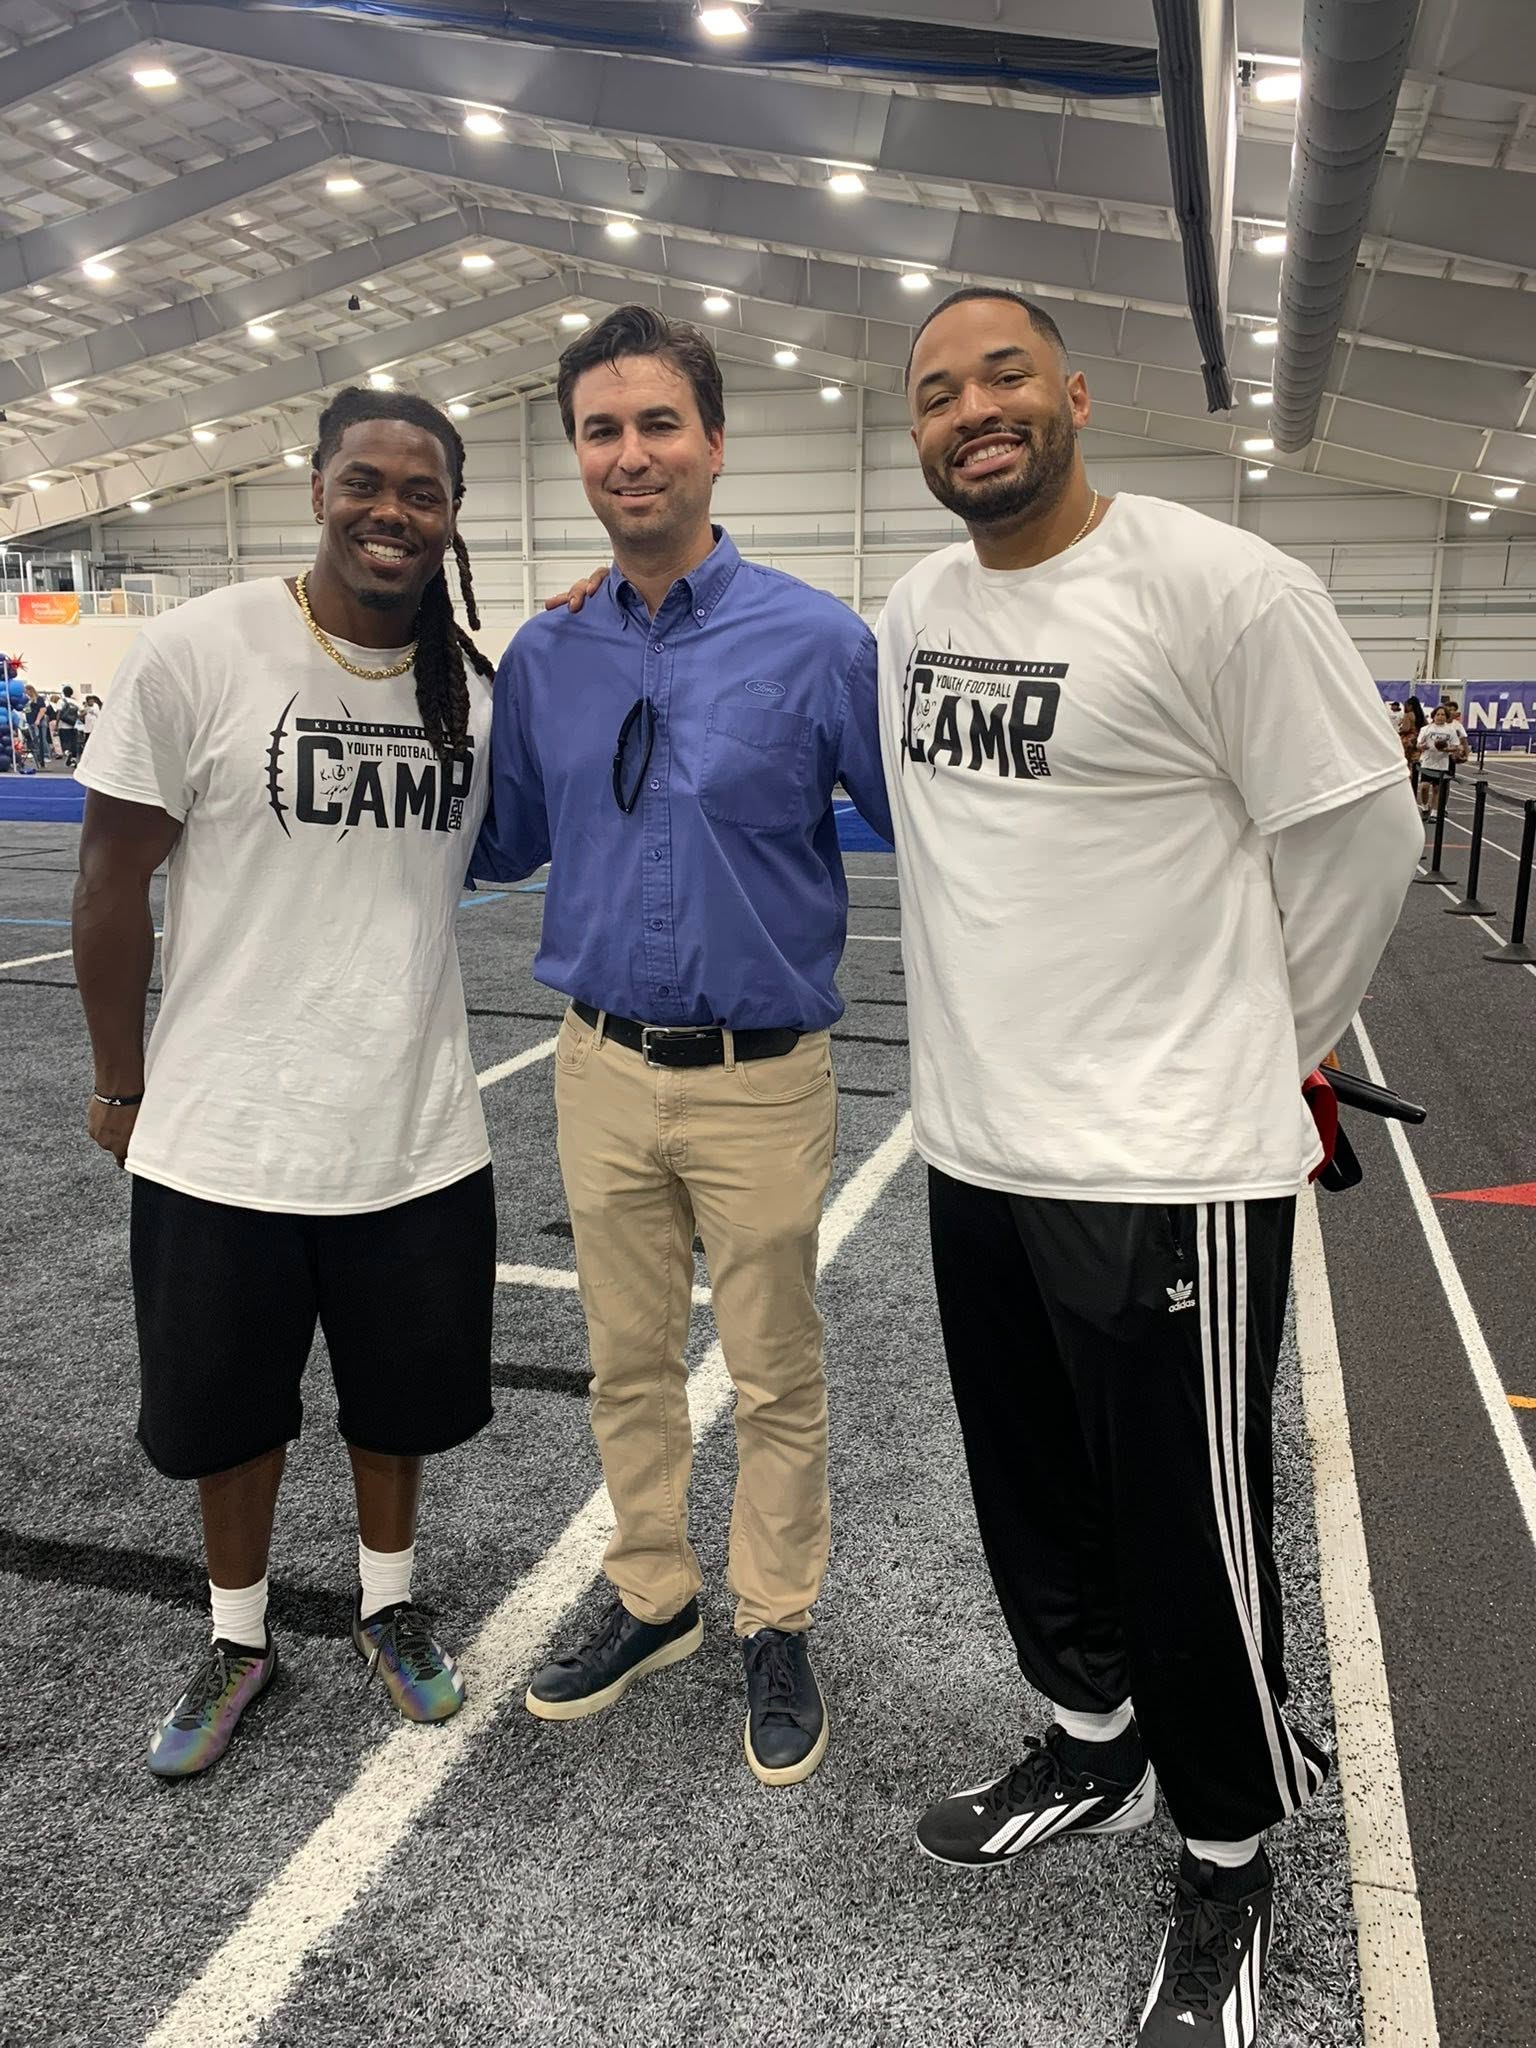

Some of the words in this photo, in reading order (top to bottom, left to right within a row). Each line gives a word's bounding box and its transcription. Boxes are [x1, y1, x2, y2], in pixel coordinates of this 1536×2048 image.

[936, 674, 962, 691] YOUTH
[963, 679, 1012, 698] FOOTBALL
[314, 721, 329, 730] KJ
[908, 668, 1061, 780] CAMP
[347, 741, 383, 757] YOUTH
[387, 743, 440, 761] FOOTBALL
[296, 736, 474, 833] CAMP
[1168, 1299, 1196, 1313] adidas
